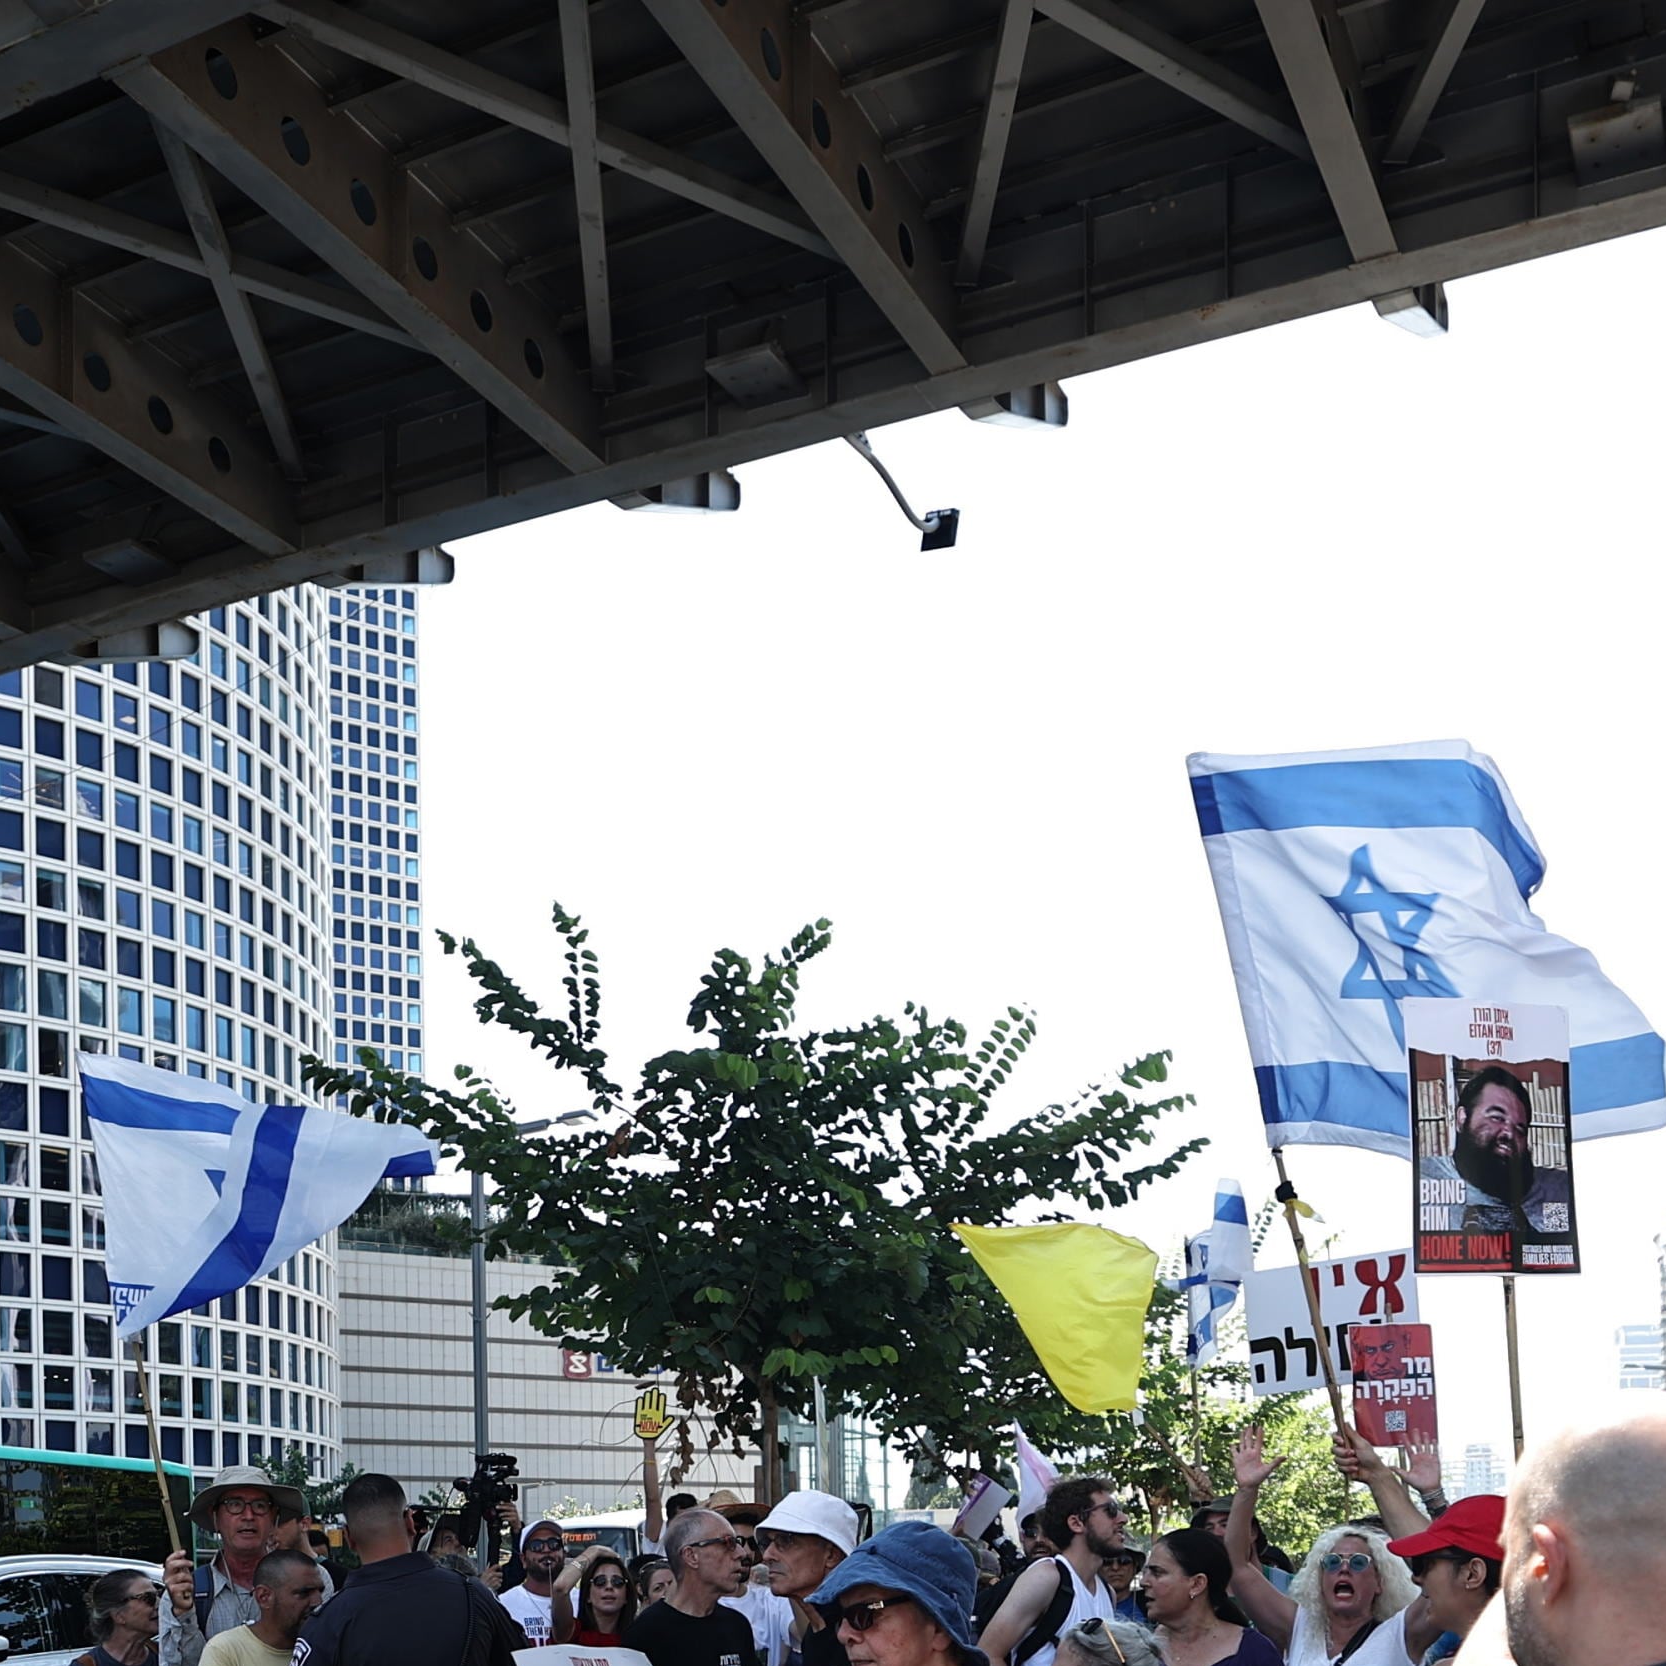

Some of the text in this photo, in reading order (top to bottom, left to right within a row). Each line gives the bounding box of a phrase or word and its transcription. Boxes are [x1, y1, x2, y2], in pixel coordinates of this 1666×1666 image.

[1469, 1023, 1514, 1041] EITAN HORN
[1486, 1039, 1502, 1057] (37)
[1419, 1178, 1466, 1205] BRING
[1419, 1206, 1450, 1231] HIM
[1419, 1233, 1512, 1261] HOME NOW!
[524, 1617, 544, 1627] BRING
[526, 1627, 543, 1636] THEM
